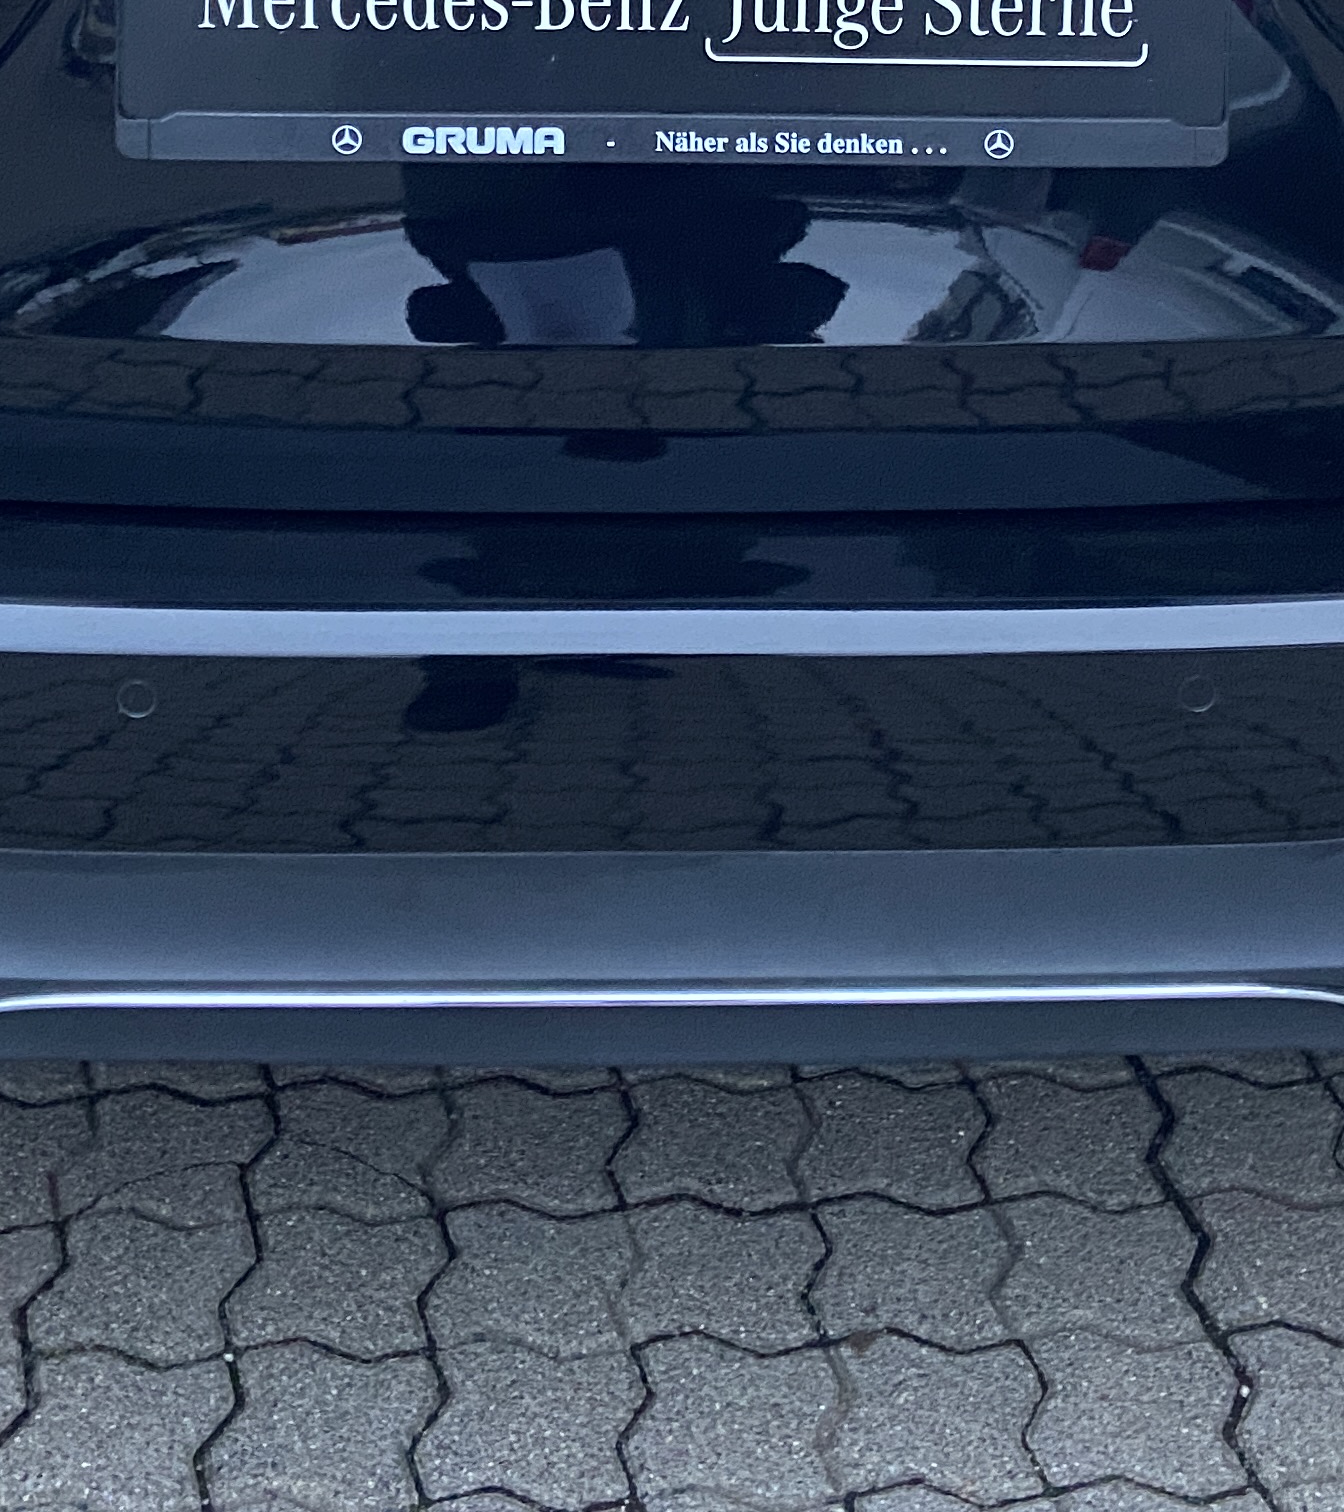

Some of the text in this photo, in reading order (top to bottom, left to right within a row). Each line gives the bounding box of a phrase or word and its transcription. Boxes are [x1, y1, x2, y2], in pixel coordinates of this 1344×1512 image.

[402, 126, 565, 155] GRUMA
[656, 131, 729, 153] Näher
[735, 132, 768, 154] als
[774, 132, 810, 154] Sie
[817, 133, 903, 155] denken
